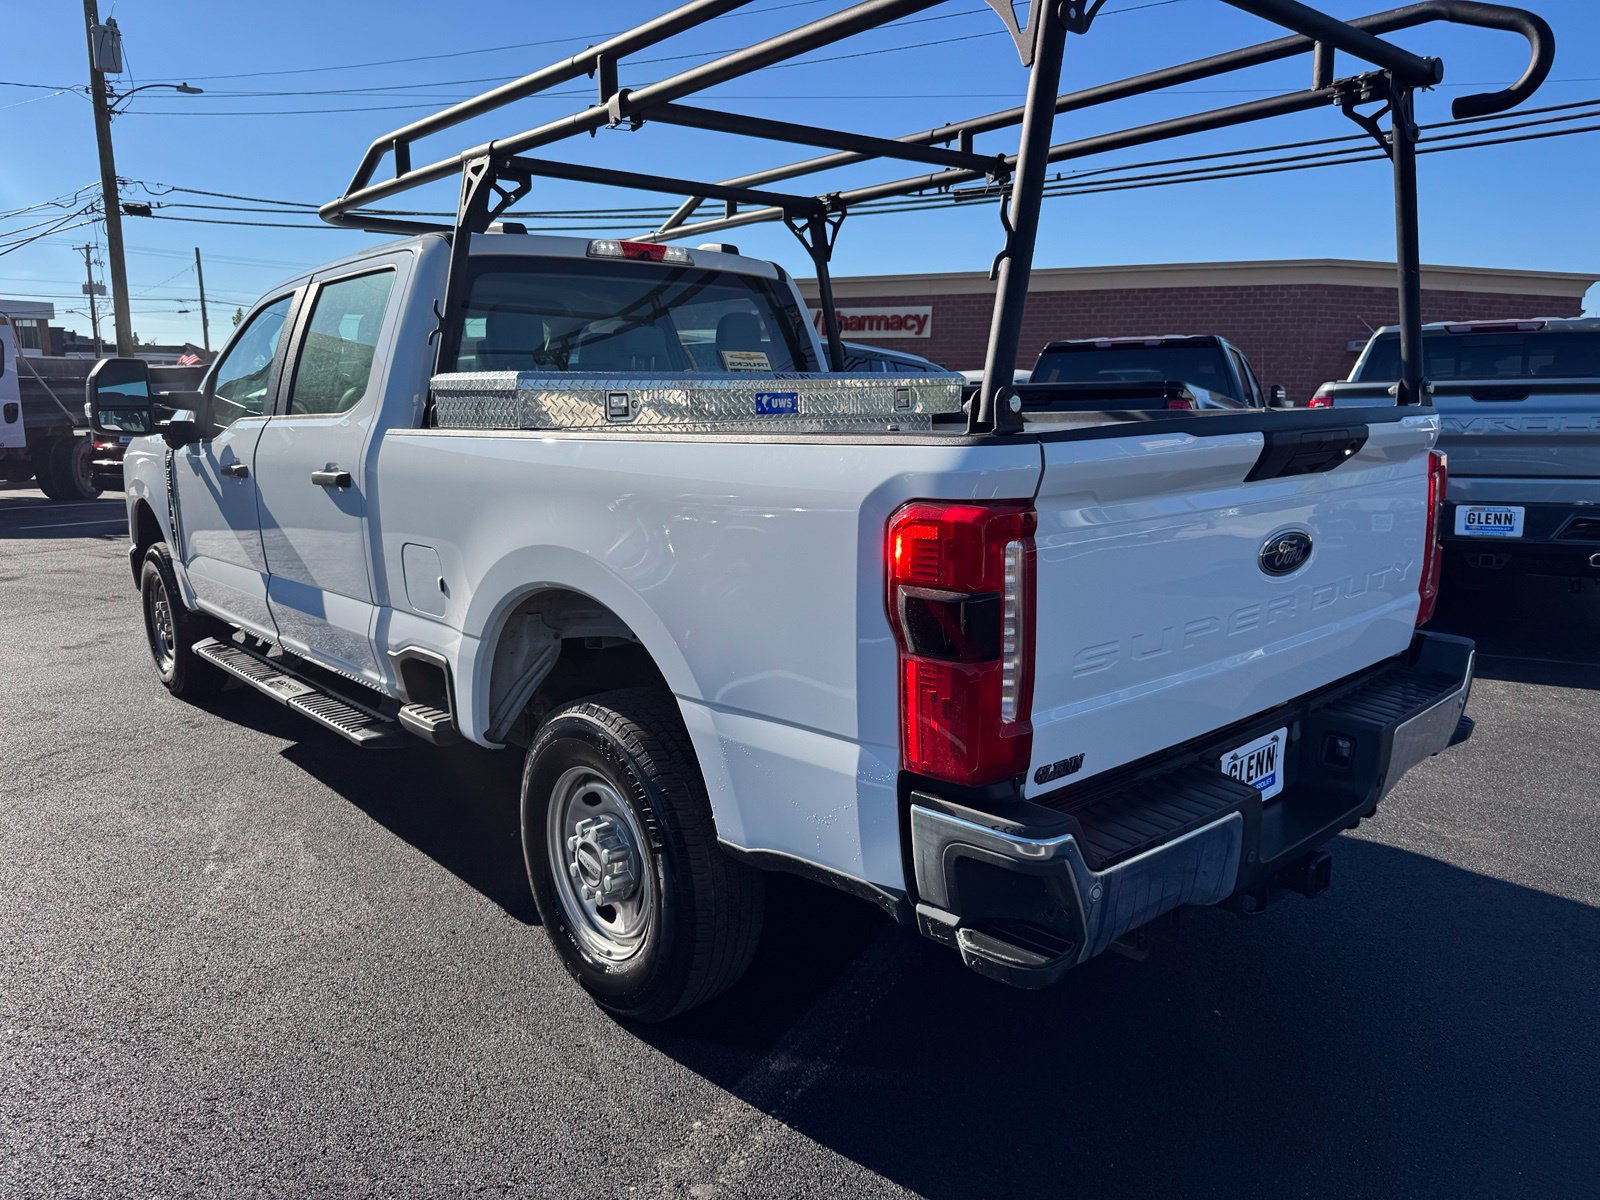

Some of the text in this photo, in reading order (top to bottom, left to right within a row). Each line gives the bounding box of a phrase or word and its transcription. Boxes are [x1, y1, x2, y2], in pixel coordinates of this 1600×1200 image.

[771, 397, 793, 409] UWS
[1467, 512, 1513, 526] GLENN
[1274, 539, 1305, 567] Ford
[1072, 559, 1414, 679] SUPER DUTY
[1033, 752, 1086, 786] GLENN
[1227, 744, 1276, 784] GLENN
